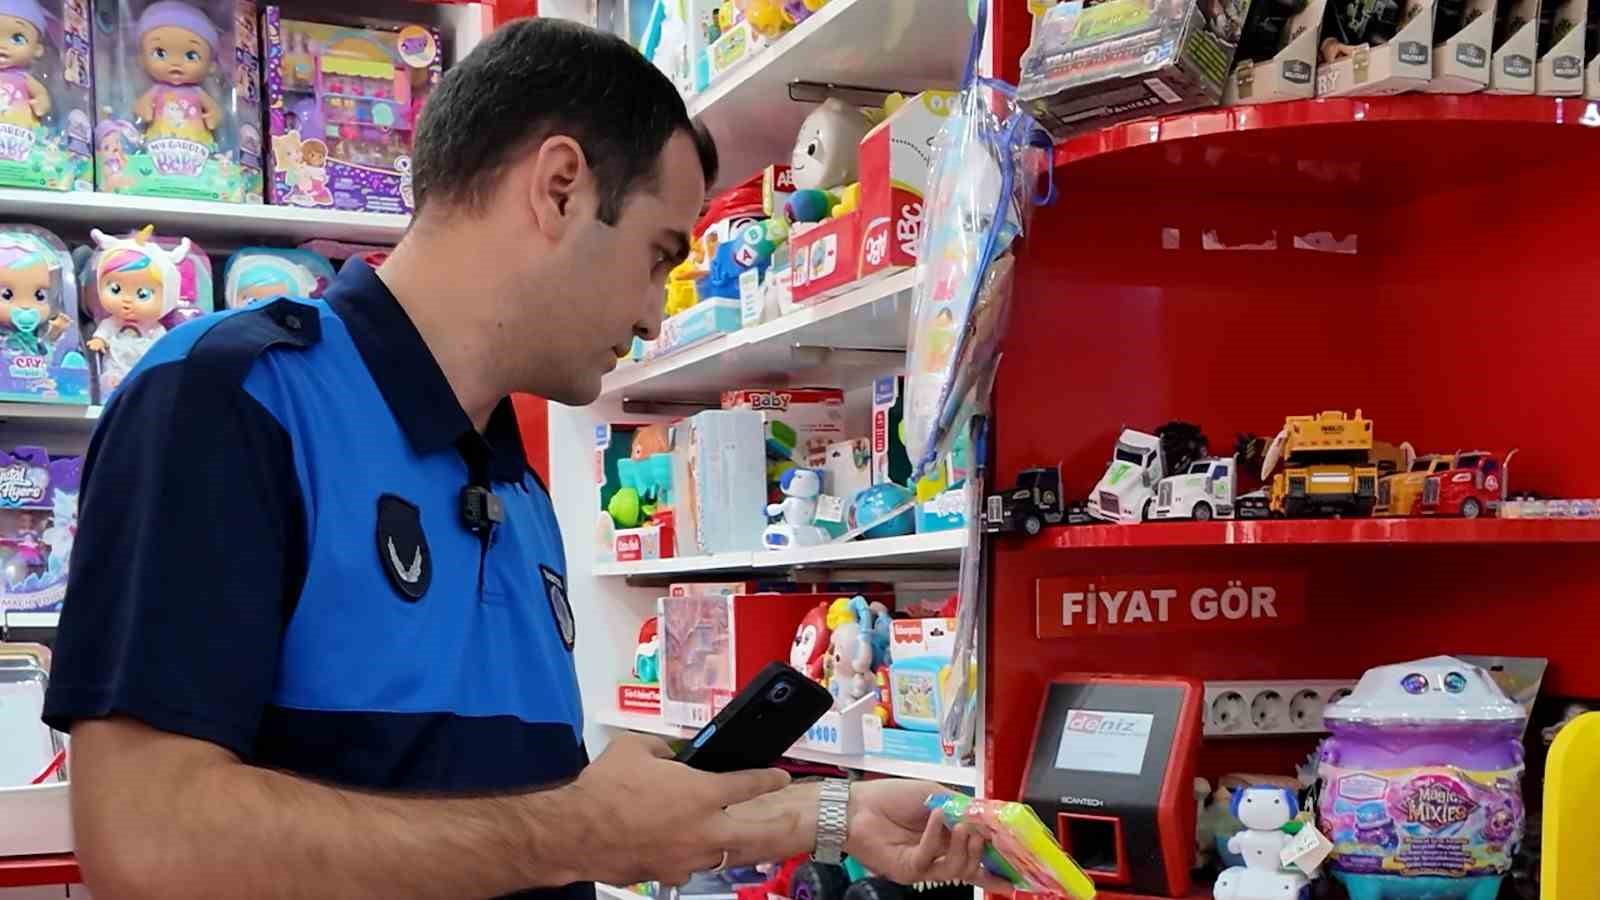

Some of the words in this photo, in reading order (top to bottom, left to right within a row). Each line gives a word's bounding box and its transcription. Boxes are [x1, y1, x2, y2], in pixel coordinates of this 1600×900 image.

[0, 124, 34, 142] ARDEN
[1061, 583, 1177, 626] FİYAT
[1190, 579, 1278, 621] GÖR
